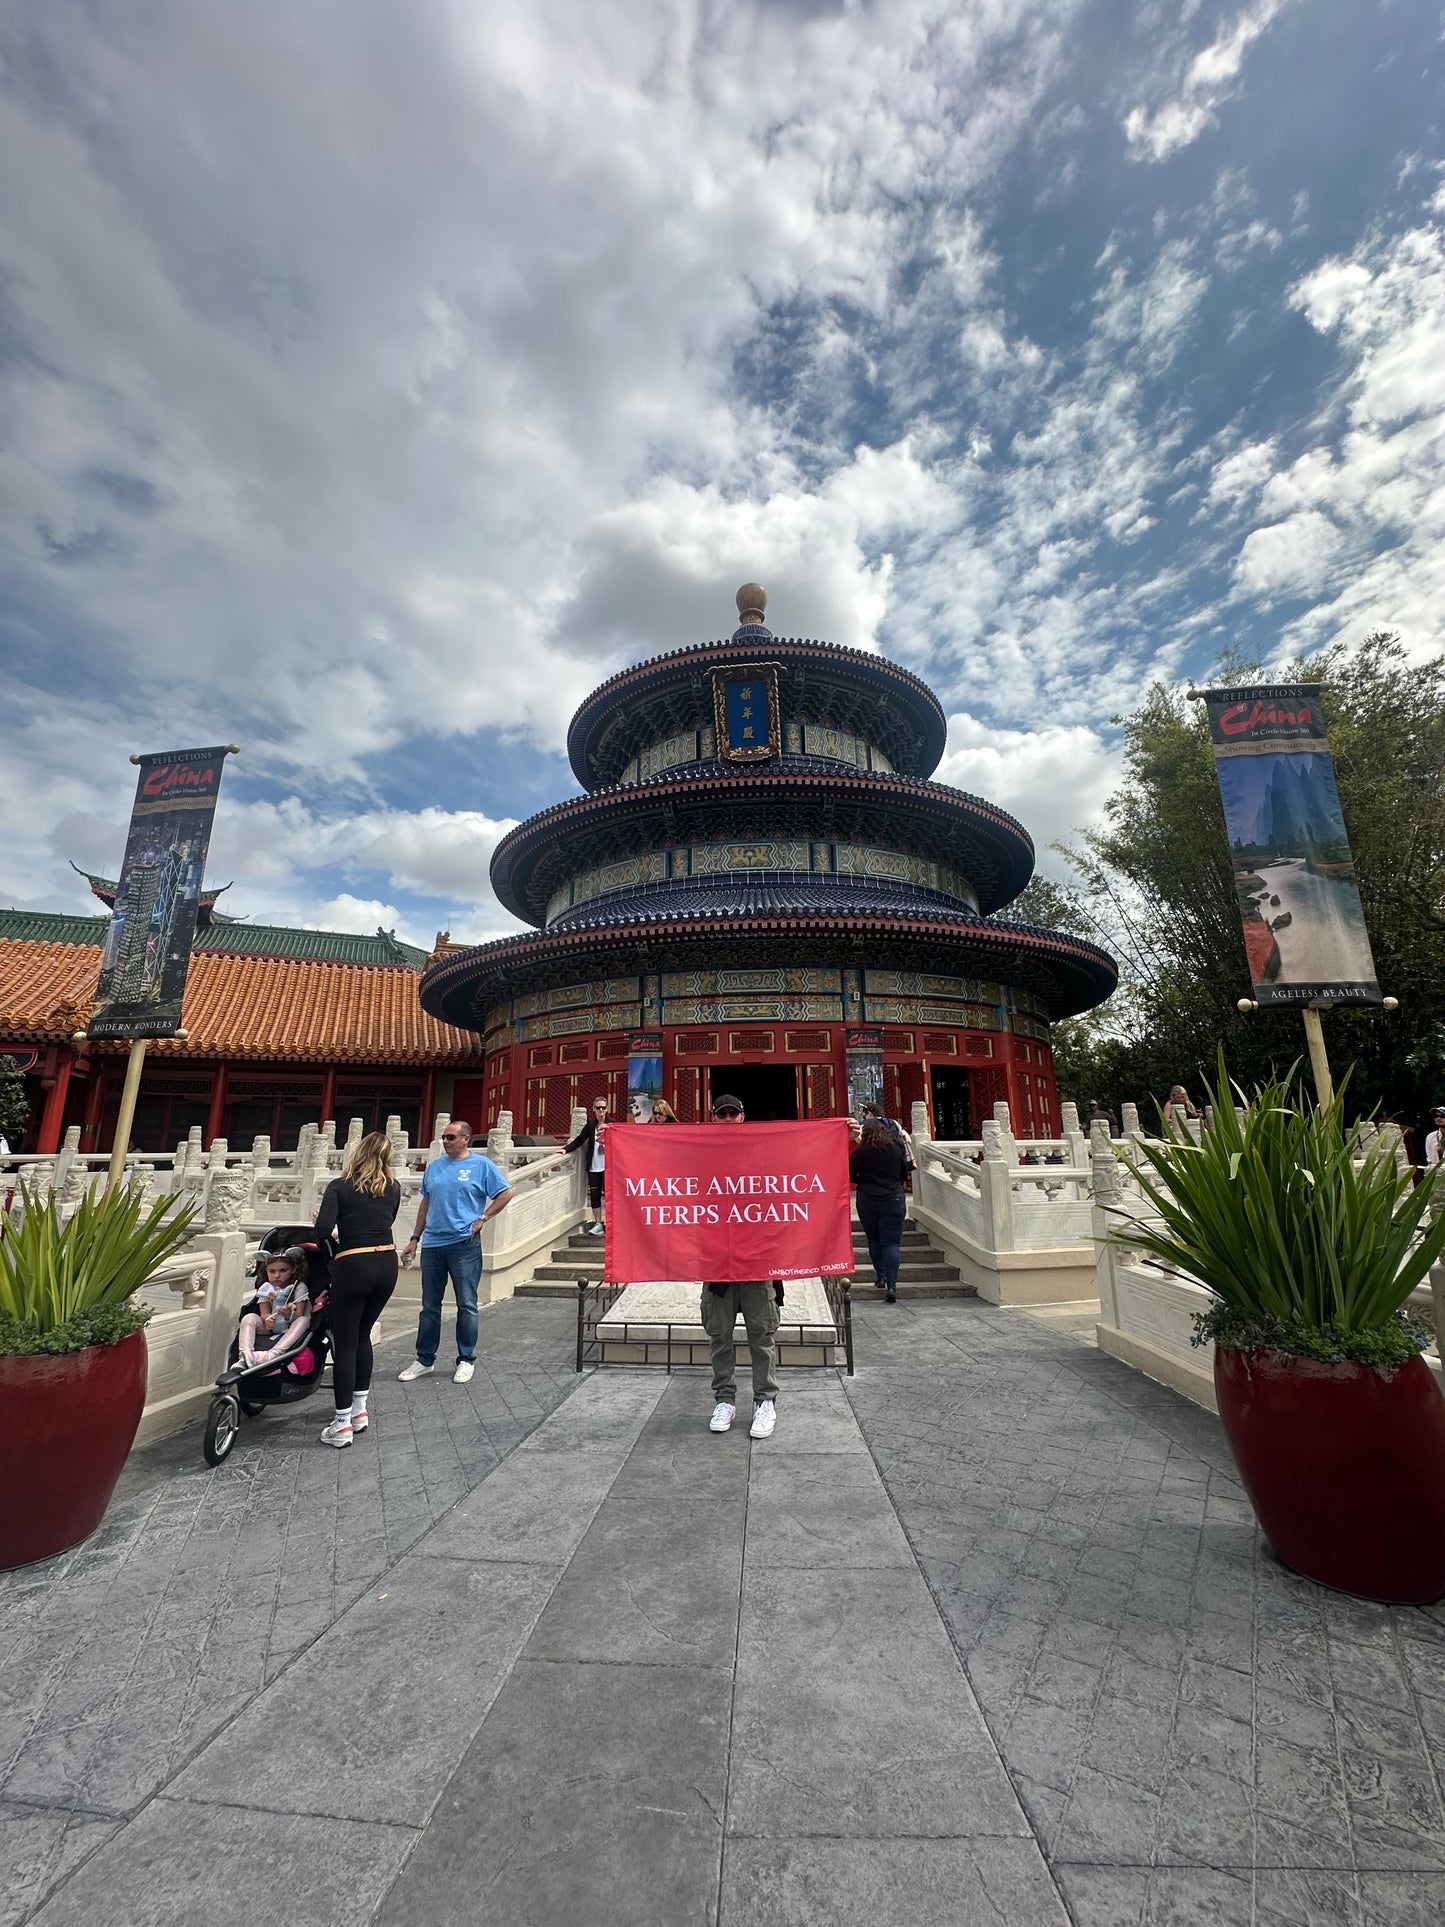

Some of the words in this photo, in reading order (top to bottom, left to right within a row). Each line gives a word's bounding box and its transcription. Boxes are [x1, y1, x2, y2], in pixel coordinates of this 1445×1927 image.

[1223, 688, 1303, 701] REFLECTIONS
[1220, 701, 1313, 735] China
[1224, 745, 1262, 753] Showing
[1263, 741, 1317, 751] Connuously
[152, 752, 212, 765] REFLECTIONS
[143, 764, 214, 795] China
[1271, 989, 1318, 999] AGELESS
[1322, 988, 1367, 998] BEAUTY
[93, 1023, 131, 1032] MODERN
[631, 1038, 660, 1050] China
[848, 1033, 879, 1046] China
[624, 1177, 699, 1197] MAKE
[706, 1173, 826, 1196] AMERICA
[641, 1204, 719, 1225] TERPS
[727, 1202, 809, 1224] AGAIN
[768, 1267, 820, 1276] UNBOTHERED
[821, 1262, 849, 1272] TOURIST
